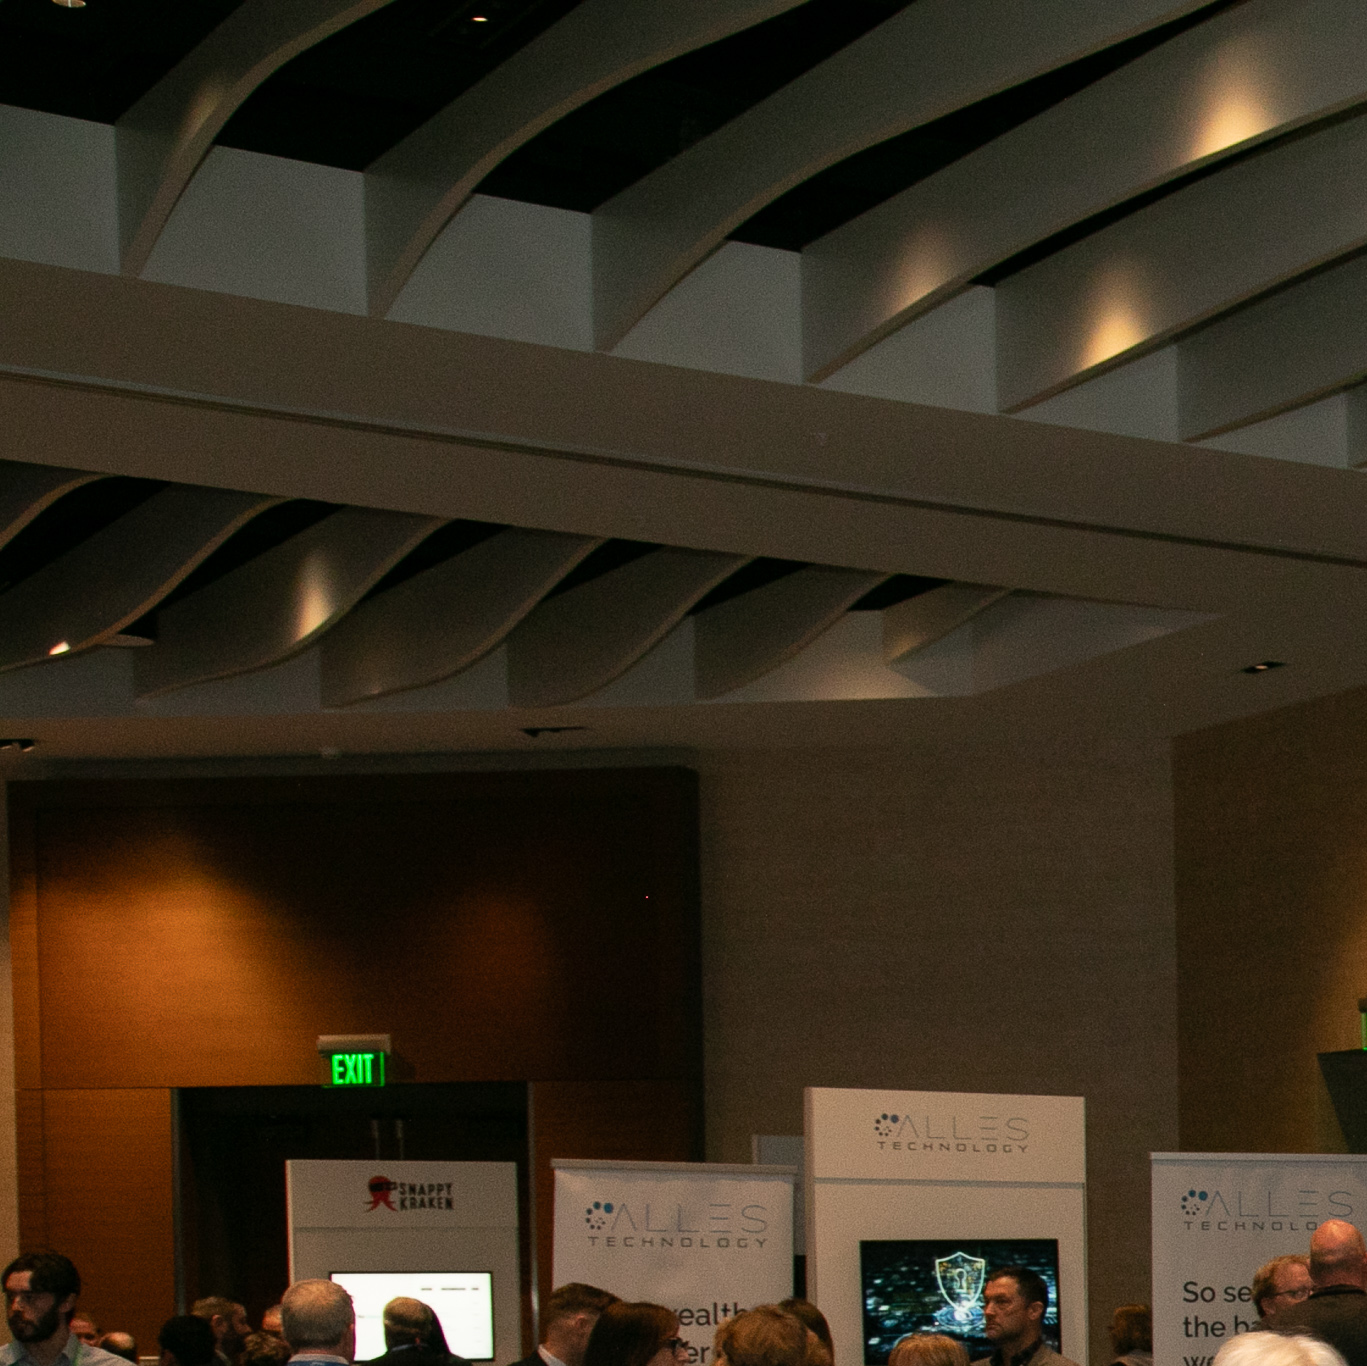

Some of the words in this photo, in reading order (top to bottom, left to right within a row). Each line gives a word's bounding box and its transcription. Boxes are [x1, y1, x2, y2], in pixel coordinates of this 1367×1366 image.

[331, 1054, 375, 1085] EXIT
[897, 1114, 1030, 1141] ALLES
[877, 1141, 1028, 1153] TECHNOLOGY
[398, 1182, 453, 1196] SNAPPY
[399, 1197, 453, 1211] KRAKEN
[1206, 1190, 1353, 1217] ALLES
[611, 1202, 768, 1234] ALLES
[1184, 1221, 1317, 1231] TECHNOLO
[588, 1236, 768, 1248] TECHNOLOGY
[1183, 1281, 1215, 1303] So
[1224, 1286, 1252, 1302] se
[1183, 1315, 1226, 1337] the
